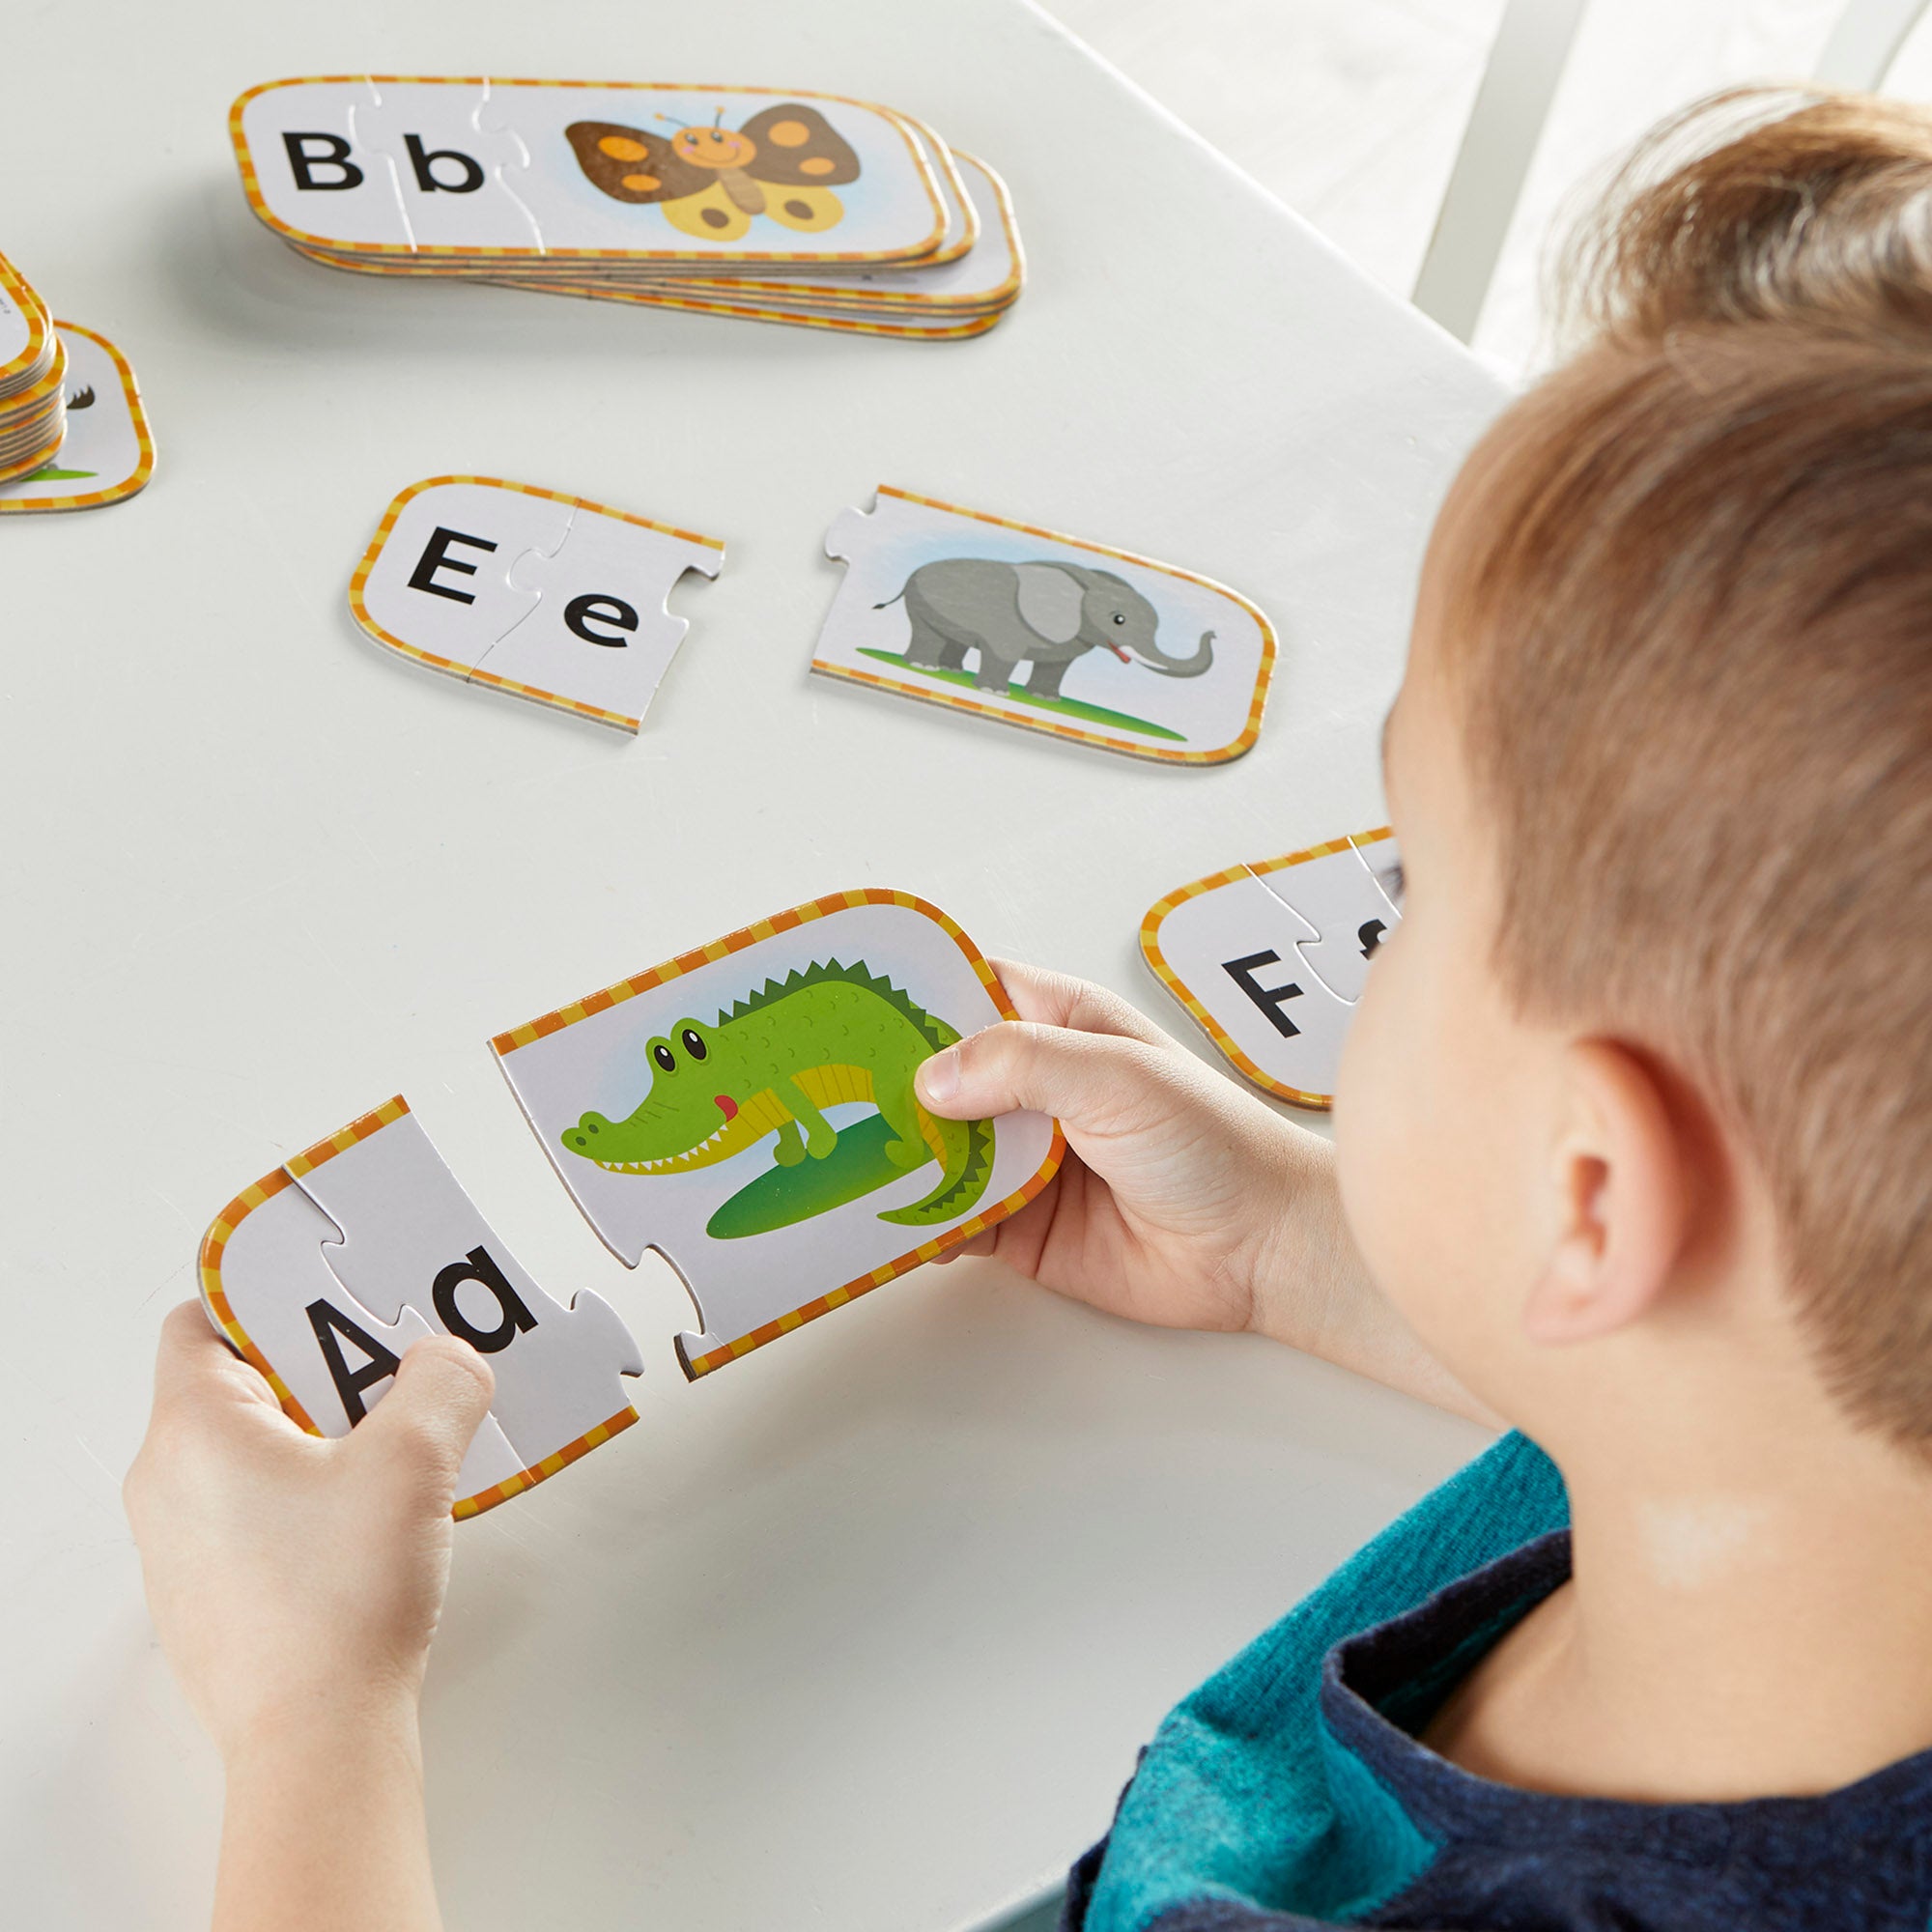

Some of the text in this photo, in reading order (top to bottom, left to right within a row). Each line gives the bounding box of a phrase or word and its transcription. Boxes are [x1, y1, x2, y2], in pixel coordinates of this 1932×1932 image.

[281, 131, 485, 193] B b
[407, 526, 639, 648] E e
[1220, 949, 1304, 1038] F
[304, 1244, 539, 1430] A a
